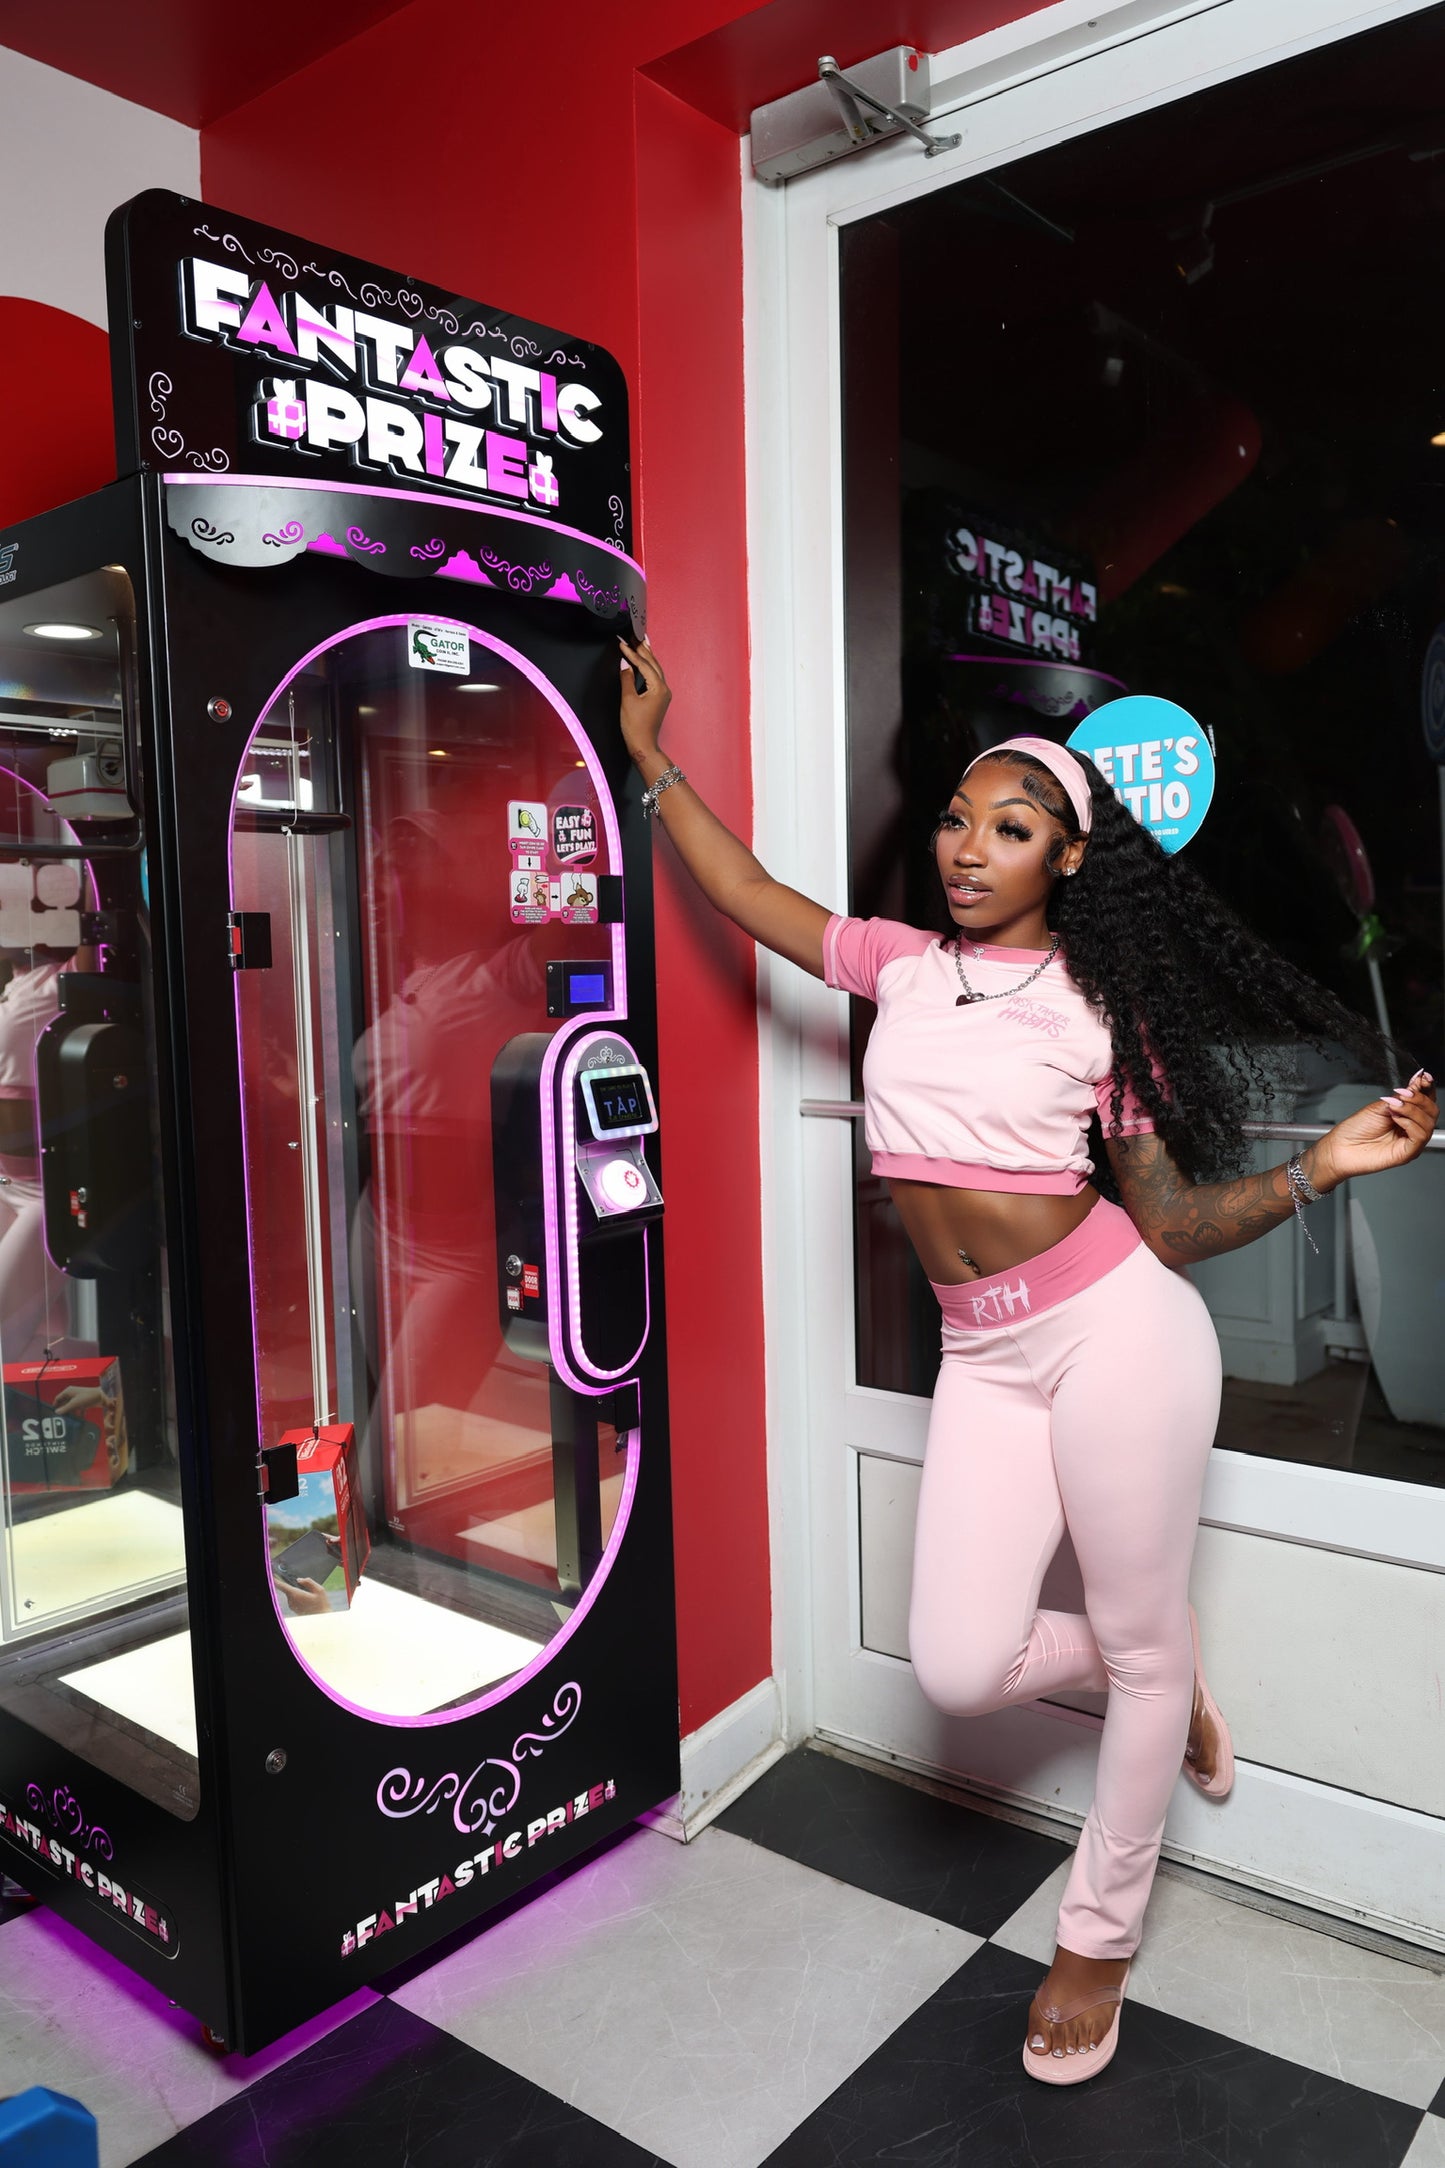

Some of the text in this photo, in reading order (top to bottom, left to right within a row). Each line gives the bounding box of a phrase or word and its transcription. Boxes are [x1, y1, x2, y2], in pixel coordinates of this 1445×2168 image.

[180, 257, 603, 448] FANTASTIC
[303, 379, 530, 500] PRIZE
[430, 638, 465, 652] GATOR
[1113, 781, 1191, 825] TIO
[555, 815, 580, 830] EASY
[570, 828, 592, 842] FUN
[556, 842, 575, 853] LET'S
[997, 1006, 1067, 1039] HABITS
[603, 1095, 637, 1117] TAP
[968, 1276, 1032, 1330] RTH
[0, 1803, 159, 1937] FANTASTIC PRIZE
[357, 1782, 606, 1949] FANTASTIC PRIZE
